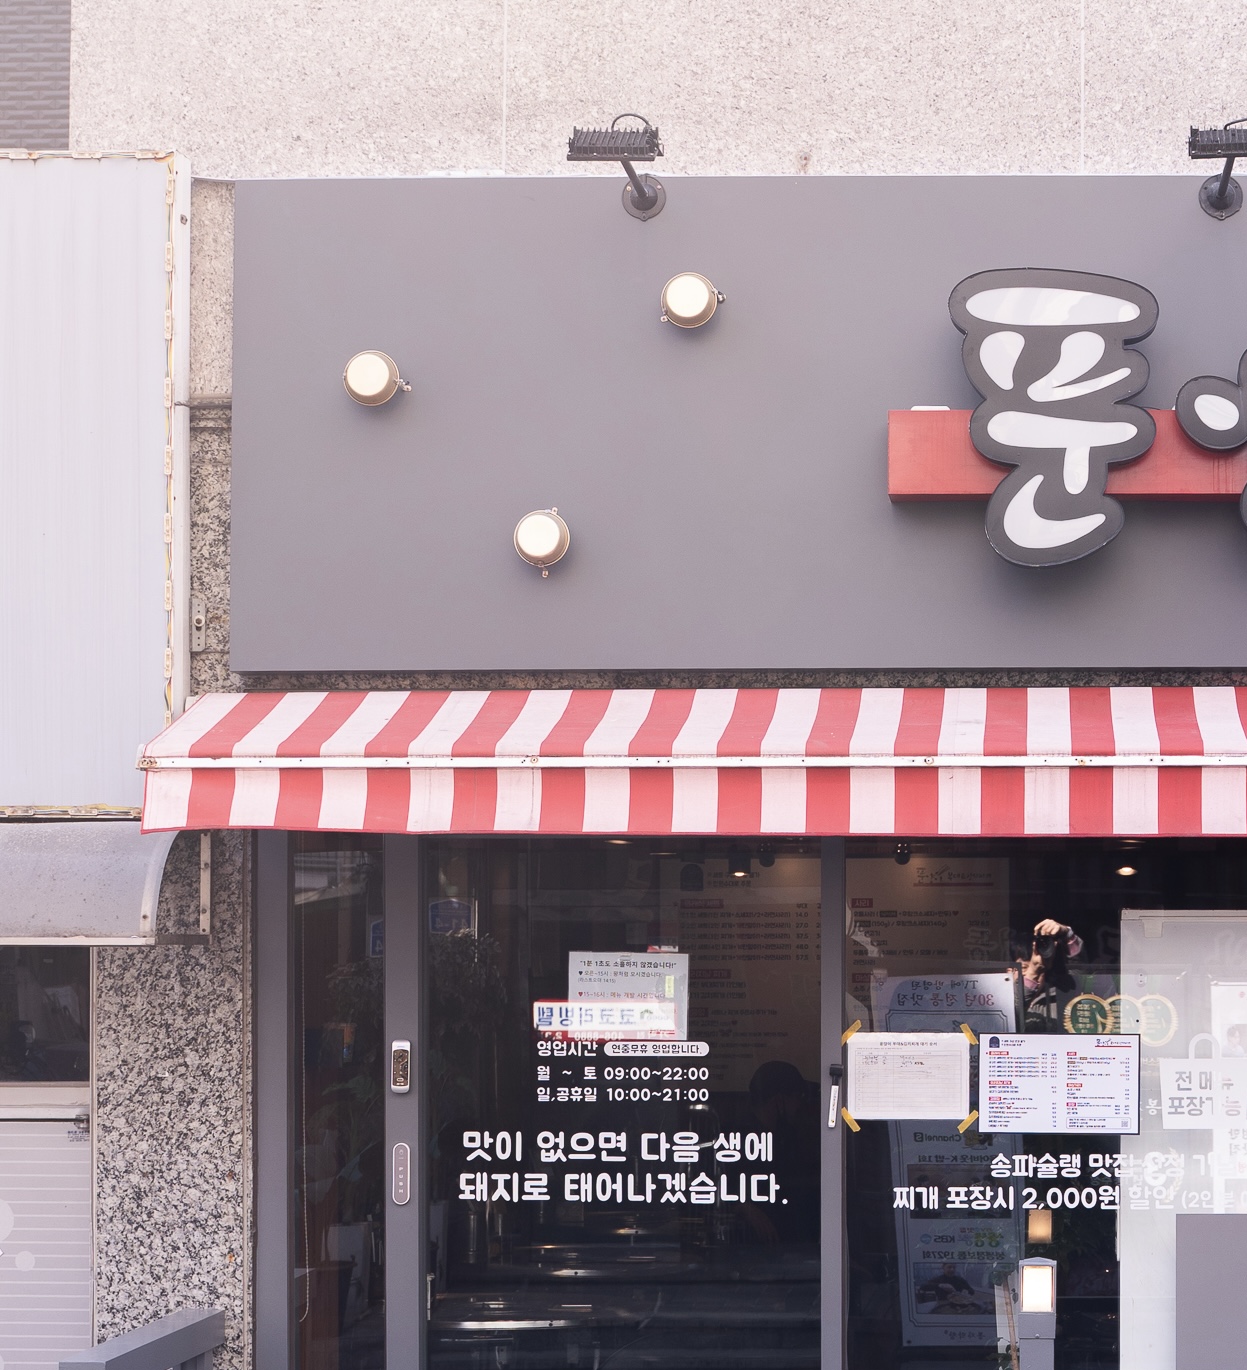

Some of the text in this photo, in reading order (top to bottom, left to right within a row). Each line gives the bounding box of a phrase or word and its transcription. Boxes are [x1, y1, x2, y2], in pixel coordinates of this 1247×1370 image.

[536, 1040, 702, 1057] 영업시간 연중무휴 영업합니다.
[537, 1065, 551, 1081] 월
[583, 1066, 597, 1081] 토
[604, 1066, 709, 1081] 09:00~22:00
[536, 1087, 709, 1102] 일,공휴일 10:00~21:00
[462, 1130, 774, 1163] 맛이 없으면 다음 생에
[990, 1153, 1082, 1179] 송파슐랭
[1089, 1153, 1134, 1178] 맛집
[458, 1172, 790, 1205] 돼지로 태어나겠습니다.
[893, 1186, 940, 1210] 찌개
[946, 1186, 1015, 1211] 포장시
[1021, 1186, 1121, 1211] 2,000원
[1128, 1186, 1175, 1210] 할인
